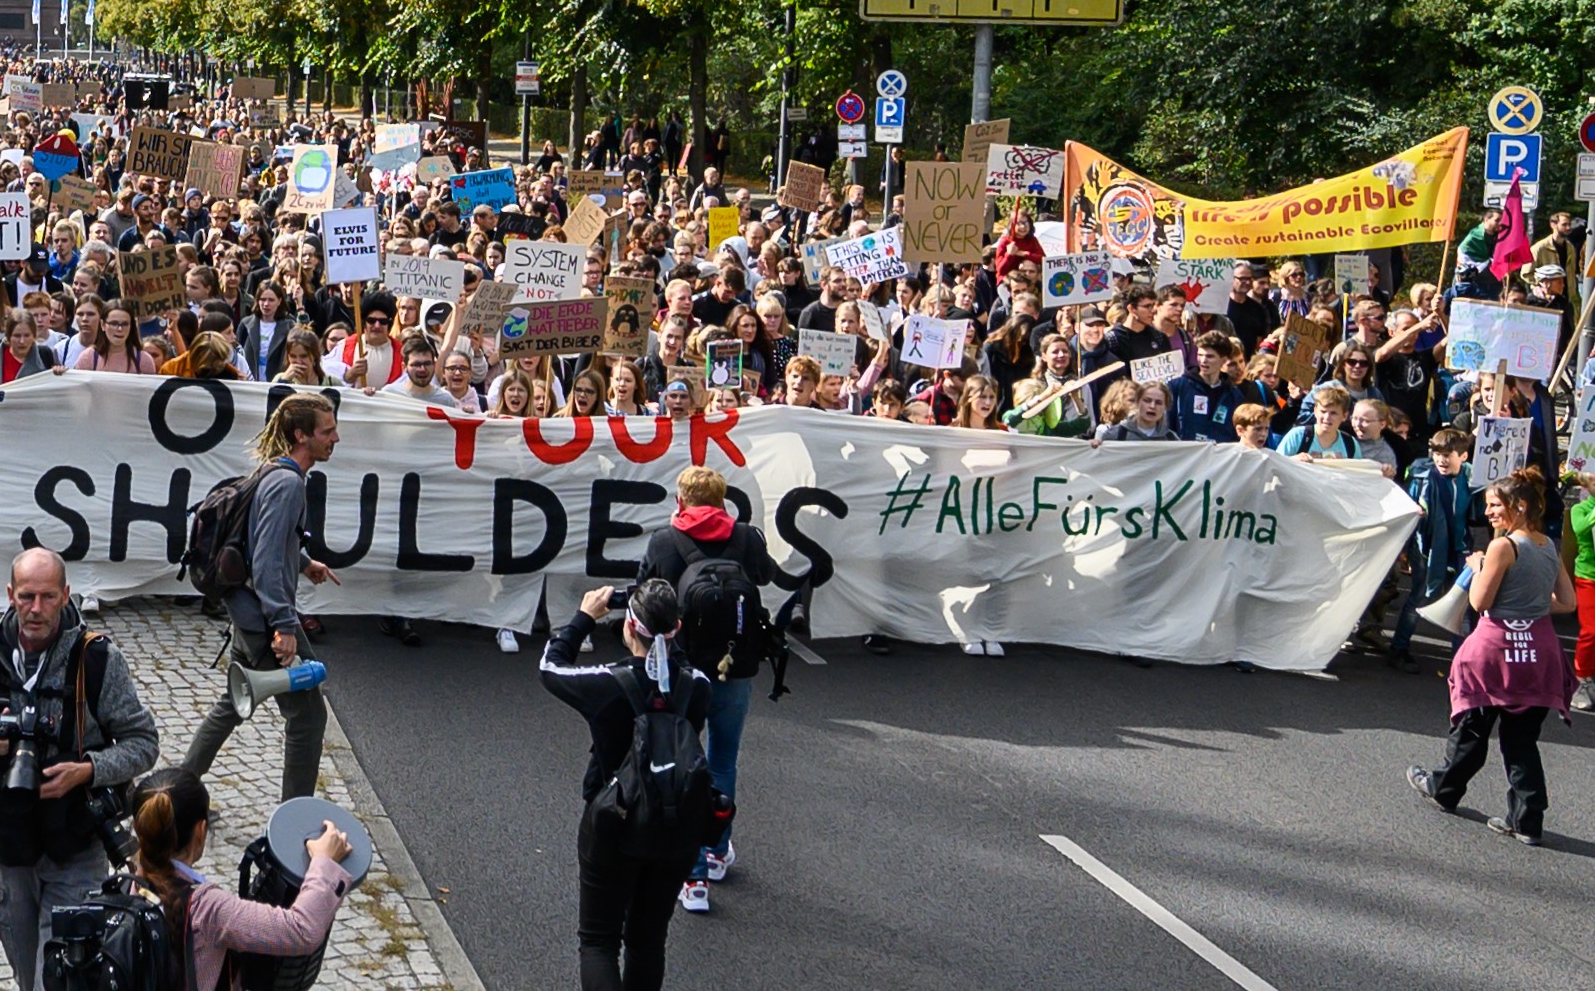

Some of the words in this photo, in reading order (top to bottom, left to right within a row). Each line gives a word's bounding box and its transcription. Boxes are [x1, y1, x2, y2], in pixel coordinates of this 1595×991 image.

[138, 132, 168, 152] WIR
[915, 168, 983, 201] NOW
[933, 204, 955, 220] or
[1283, 184, 1418, 225] possible
[333, 224, 368, 235] ELVIS
[905, 221, 982, 254] NEVER
[1194, 233, 1250, 246] Create
[1255, 225, 1355, 245] sustainable
[1360, 217, 1447, 236] Ecovillages
[339, 236, 365, 246] FOR
[832, 243, 861, 259] THIS
[882, 232, 894, 244] IS
[151, 249, 176, 270] ES
[328, 245, 376, 258] FUTURE
[1085, 254, 1099, 264] NO
[390, 260, 400, 268] IN
[402, 259, 431, 275] 2019
[514, 247, 578, 275] SYSTEM
[394, 271, 453, 289] TITANIC
[515, 272, 566, 288] CHANGE
[1174, 262, 1225, 281] STARK
[526, 288, 555, 299] NOT
[531, 307, 552, 320] DIE
[557, 302, 594, 318] ERDE
[528, 321, 554, 336] HAT
[557, 317, 599, 333] FIEBER
[502, 339, 534, 354] SAGT
[536, 338, 560, 350] DER
[561, 335, 601, 349] BIBER
[1134, 360, 1156, 371] LIKE
[1161, 356, 1172, 367] THE
[1136, 369, 1151, 380] SEA
[1153, 364, 1178, 378] LEVEL
[1505, 631, 1534, 641] REBEL
[1504, 649, 1537, 662] LIFE
